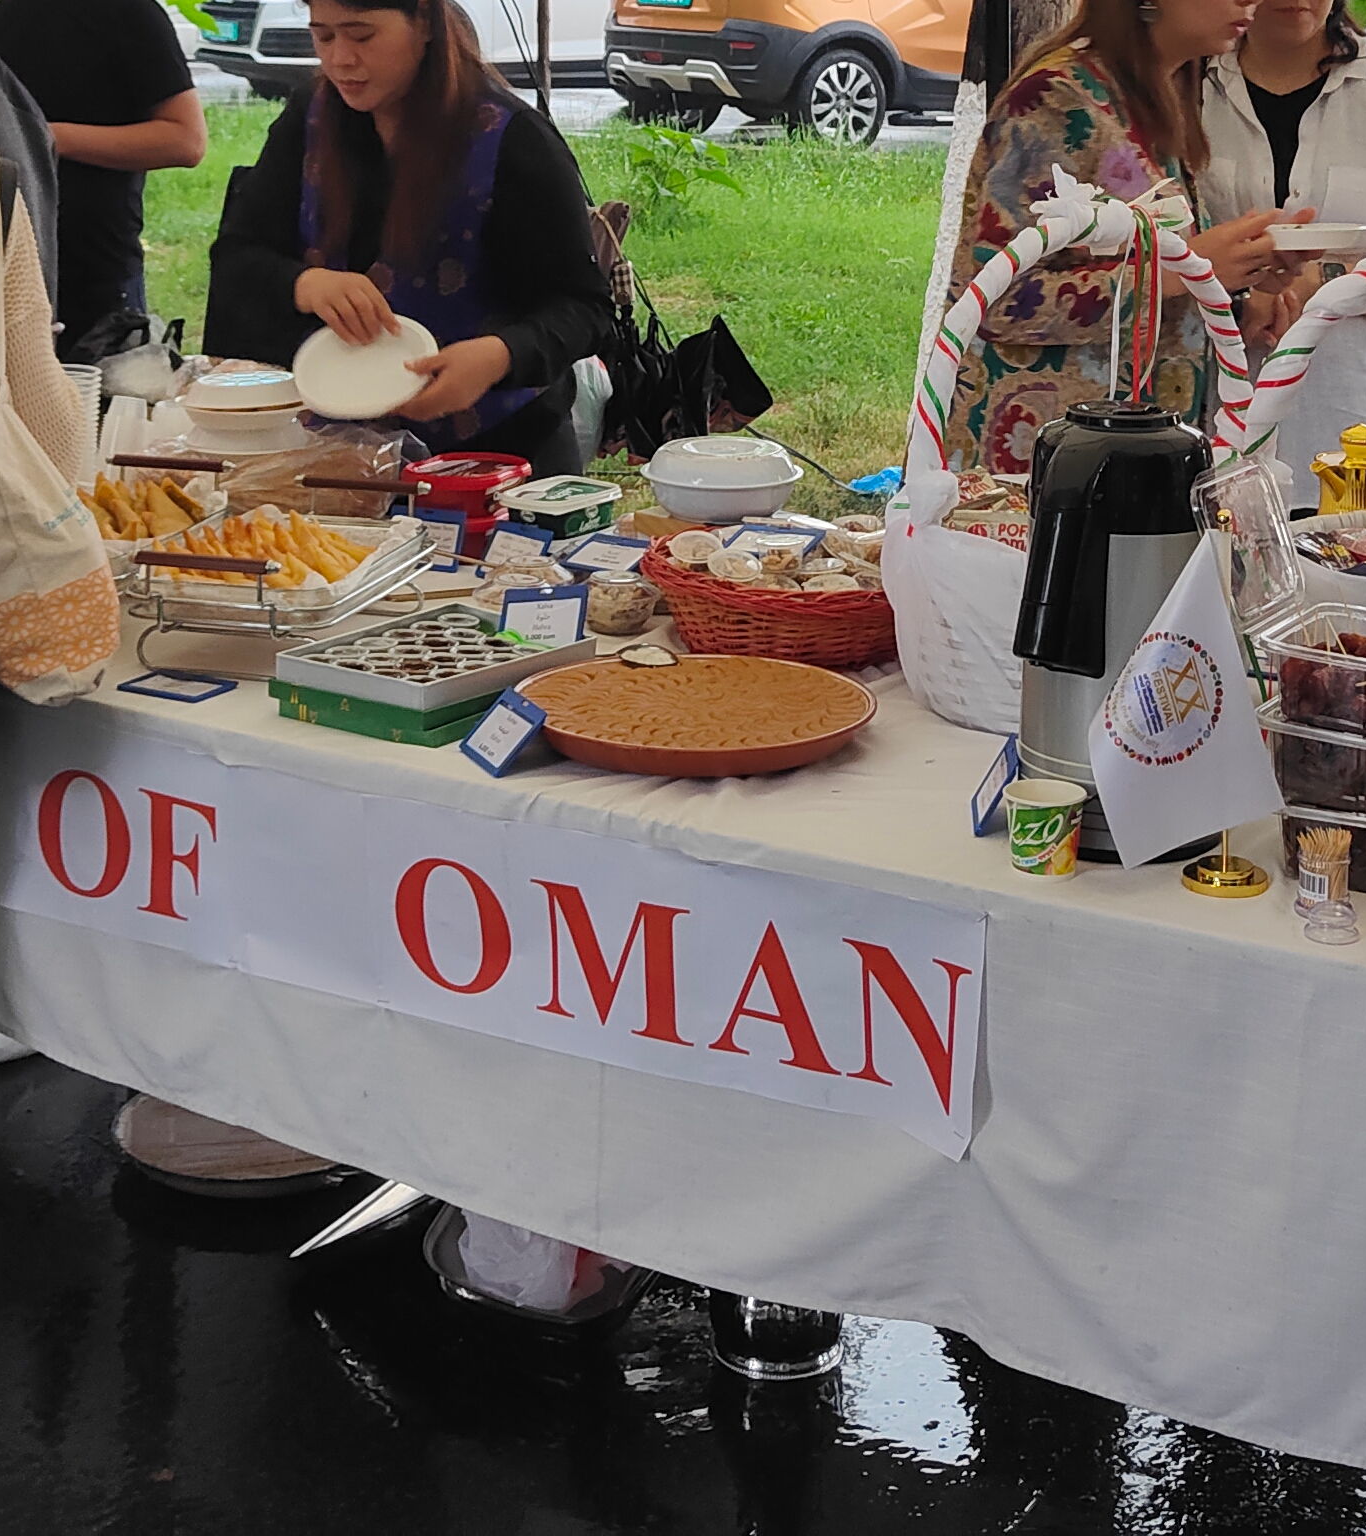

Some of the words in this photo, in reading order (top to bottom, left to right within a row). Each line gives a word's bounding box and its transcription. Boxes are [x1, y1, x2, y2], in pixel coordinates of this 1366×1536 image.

[998, 523, 1028, 538] POF
[1152, 670, 1174, 727] FESTIVAL
[1163, 655, 1210, 724] XX
[38, 768, 216, 921] OF
[395, 858, 972, 1116] OMAN
